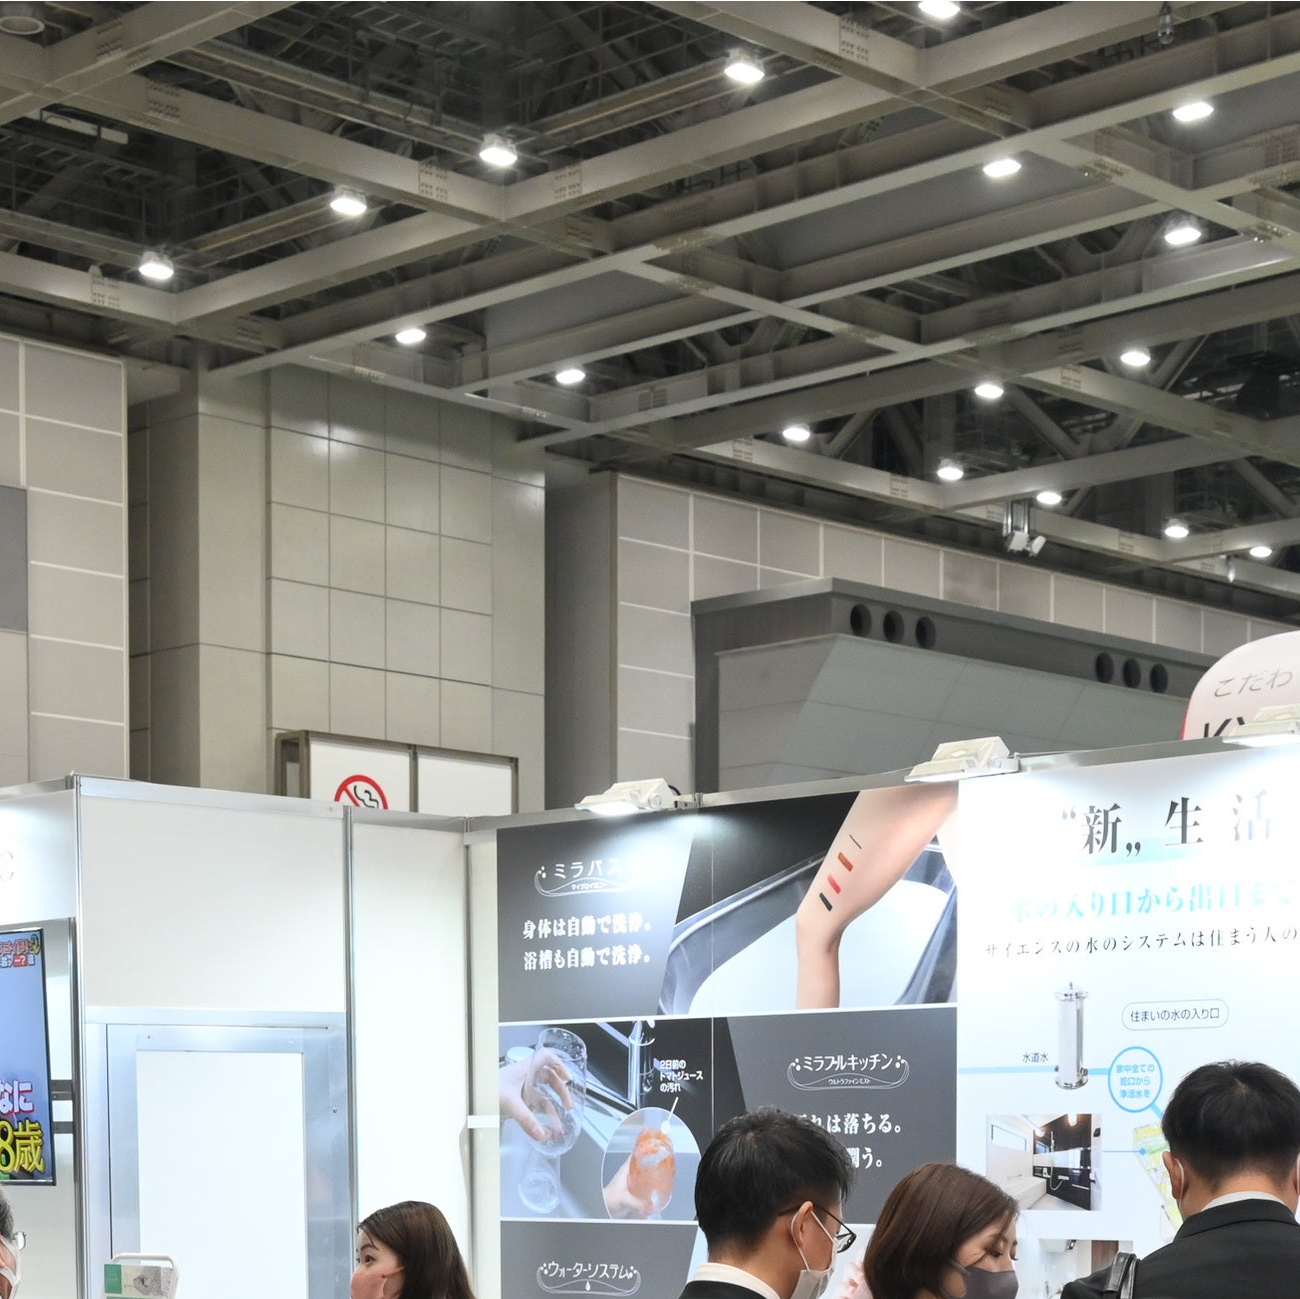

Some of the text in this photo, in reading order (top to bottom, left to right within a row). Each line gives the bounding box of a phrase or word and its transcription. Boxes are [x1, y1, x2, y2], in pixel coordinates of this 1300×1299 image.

[522, 911, 652, 940] 身体は自動で洗浄。
[523, 943, 651, 971] 浴槽も自動で洗浄。
[1130, 1007, 1220, 1023] 住まいの水の入り口
[1022, 1051, 1050, 1063] 水道水
[659, 1059, 687, 1071] 2日前の
[659, 1070, 704, 1082] トマトジュース
[659, 1081, 682, 1093] の汚れ
[799, 1112, 901, 1135] は落ちる。
